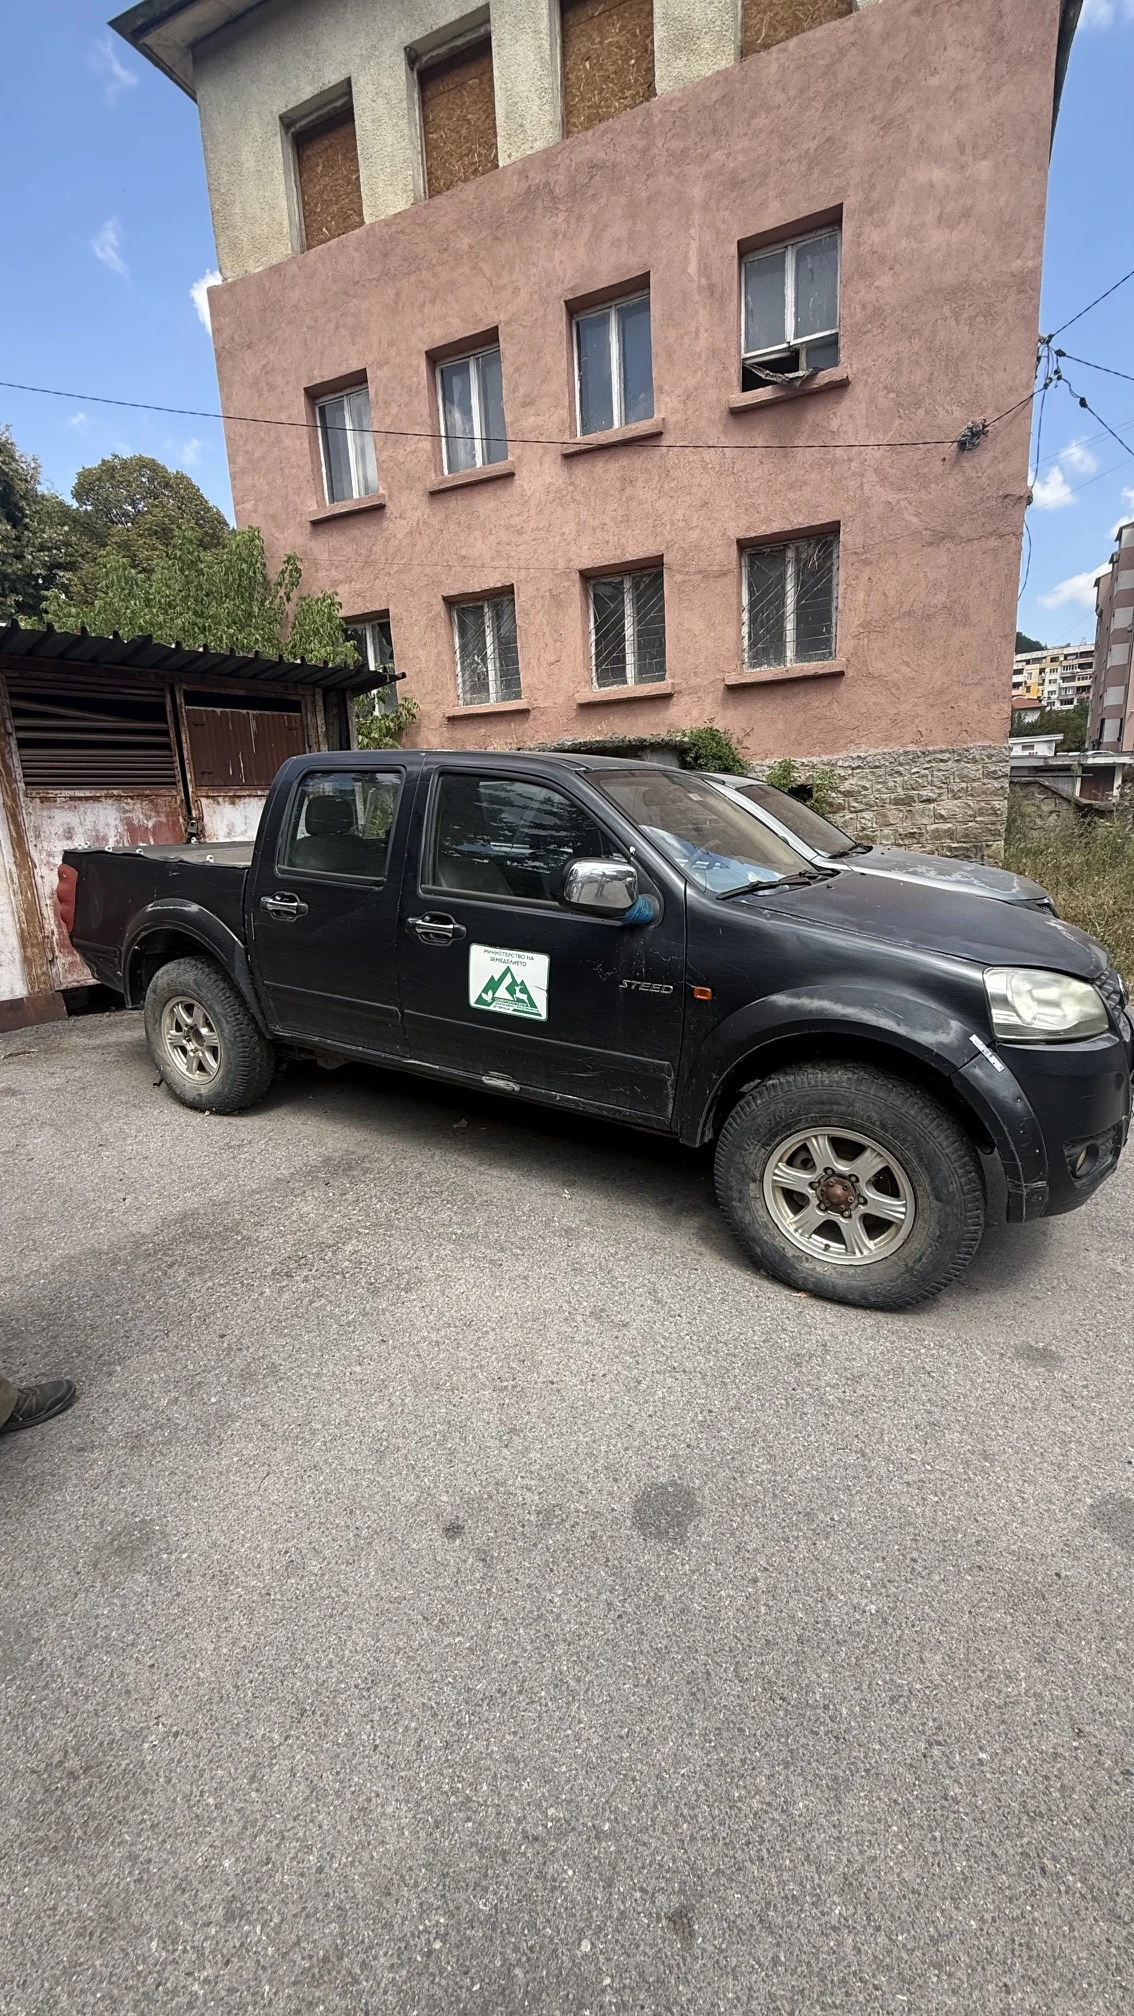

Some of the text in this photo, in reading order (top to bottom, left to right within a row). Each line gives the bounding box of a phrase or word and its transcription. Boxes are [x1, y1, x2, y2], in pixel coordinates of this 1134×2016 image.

[484, 949, 525, 959] МИНИСТЕРСТВО
[490, 957, 527, 967] ЗЕМЕДЕЛИЕТО
[619, 979, 674, 994] STEED
